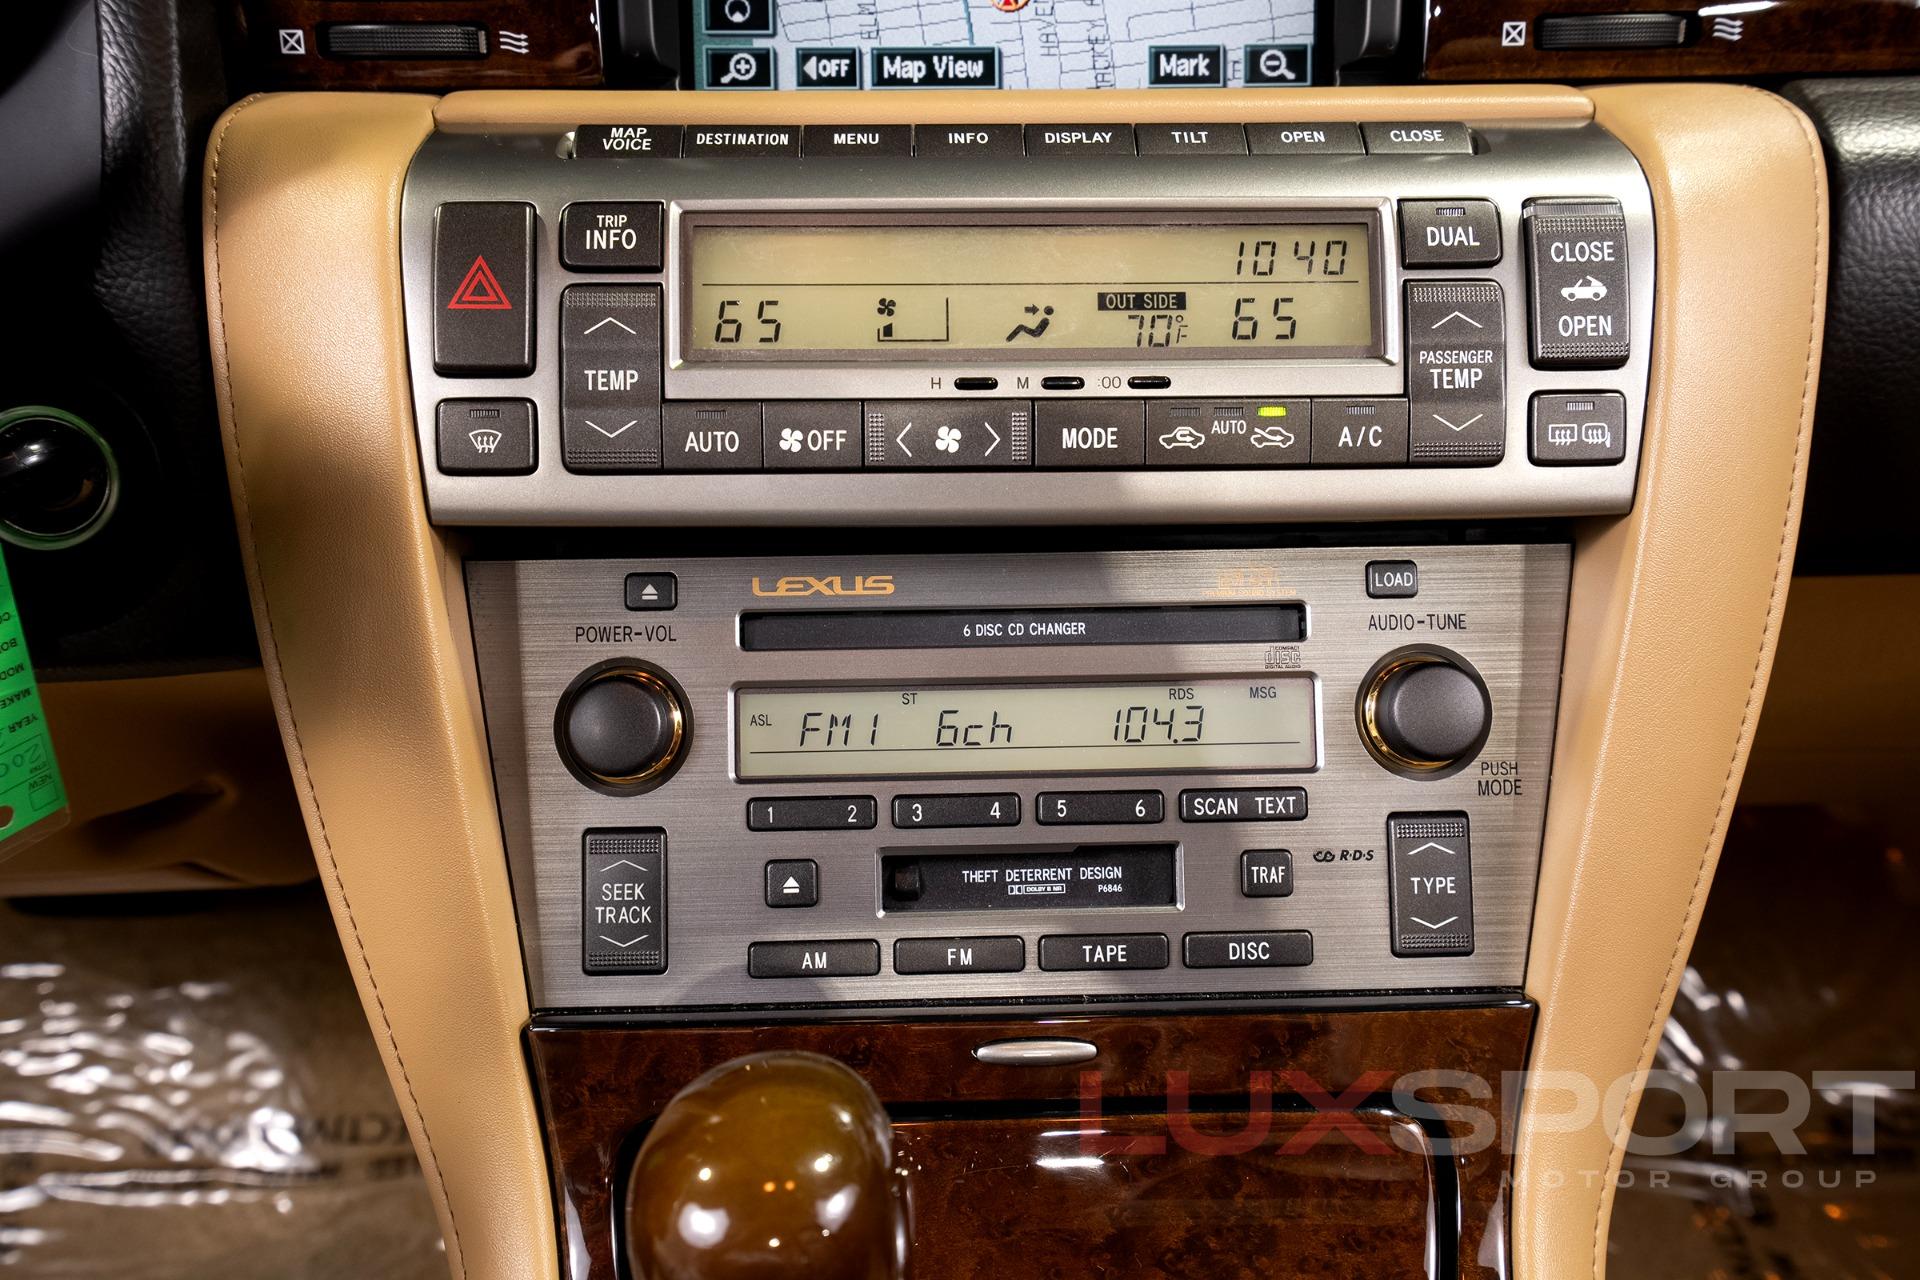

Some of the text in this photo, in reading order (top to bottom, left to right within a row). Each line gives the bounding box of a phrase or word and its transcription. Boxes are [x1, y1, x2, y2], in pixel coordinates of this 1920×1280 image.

[1035, 0, 1055, 56] HAVE
[817, 60, 850, 77] OFF
[883, 55, 983, 83] Map View
[1160, 53, 1211, 77] Mark
[611, 127, 647, 139] MAP
[696, 133, 789, 146] DESTINATION
[833, 133, 879, 145] MENU
[948, 132, 988, 144] INFO
[1044, 131, 1112, 145] DISPLAY
[1171, 131, 1208, 144] TILT
[1281, 130, 1325, 144] OPEN
[1390, 129, 1444, 143] CLOSE
[602, 138, 651, 151] VOICE
[597, 215, 627, 227] TRIP
[586, 230, 637, 250] INFO
[1426, 227, 1479, 246] DUAL
[1550, 242, 1614, 262] CLOSE
[1105, 294, 1180, 309] OUT SIDE
[714, 300, 782, 343] 65
[1232, 297, 1295, 341] 65
[1558, 315, 1612, 337] OPEN
[1419, 350, 1492, 365] PASSENGER
[584, 370, 638, 391] TEMP
[931, 377, 941, 390] H
[1017, 376, 1029, 390] M
[1430, 369, 1482, 389] TEMP
[1211, 420, 1246, 435] AUTO
[685, 431, 739, 453] AUTO
[808, 431, 847, 452] OFF
[1062, 427, 1118, 449] MODE
[1339, 426, 1382, 448] A/C
[752, 576, 895, 596] LEXUS
[1375, 573, 1412, 587] LOAD
[963, 622, 1086, 637] 6 DISC CD CHANGER
[1368, 614, 1466, 630] AUDIO-TUNE
[575, 625, 676, 643] POWER-VOL
[902, 693, 917, 705] ST
[1169, 688, 1194, 700] RDS
[1249, 687, 1277, 699] MSG
[8, 713, 38, 733] YEAR
[750, 714, 772, 727] ASL
[935, 710, 1012, 746] 6ch
[1114, 705, 1205, 743] 104.3
[1481, 761, 1518, 776] PUSH
[1477, 780, 1522, 797] MODE
[912, 804, 922, 822] 3
[990, 802, 1001, 819] 4
[1057, 800, 1066, 817] 5
[1135, 800, 1145, 817] 6
[1194, 798, 1238, 815] SCAN
[1255, 796, 1296, 814] TEXT
[767, 807, 774, 823] 1
[847, 806, 857, 822] 2
[962, 867, 1122, 883] THEFT DETERRENT DESIGN
[1252, 867, 1285, 884] TRAF
[602, 883, 645, 901] SEEK
[1098, 884, 1122, 893] P6846
[1411, 877, 1455, 894] TYPE
[595, 906, 651, 924] TRACK
[947, 949, 972, 966] FM
[1083, 945, 1127, 962] TAPE
[1229, 943, 1270, 960] DISC
[802, 952, 827, 970] AM
